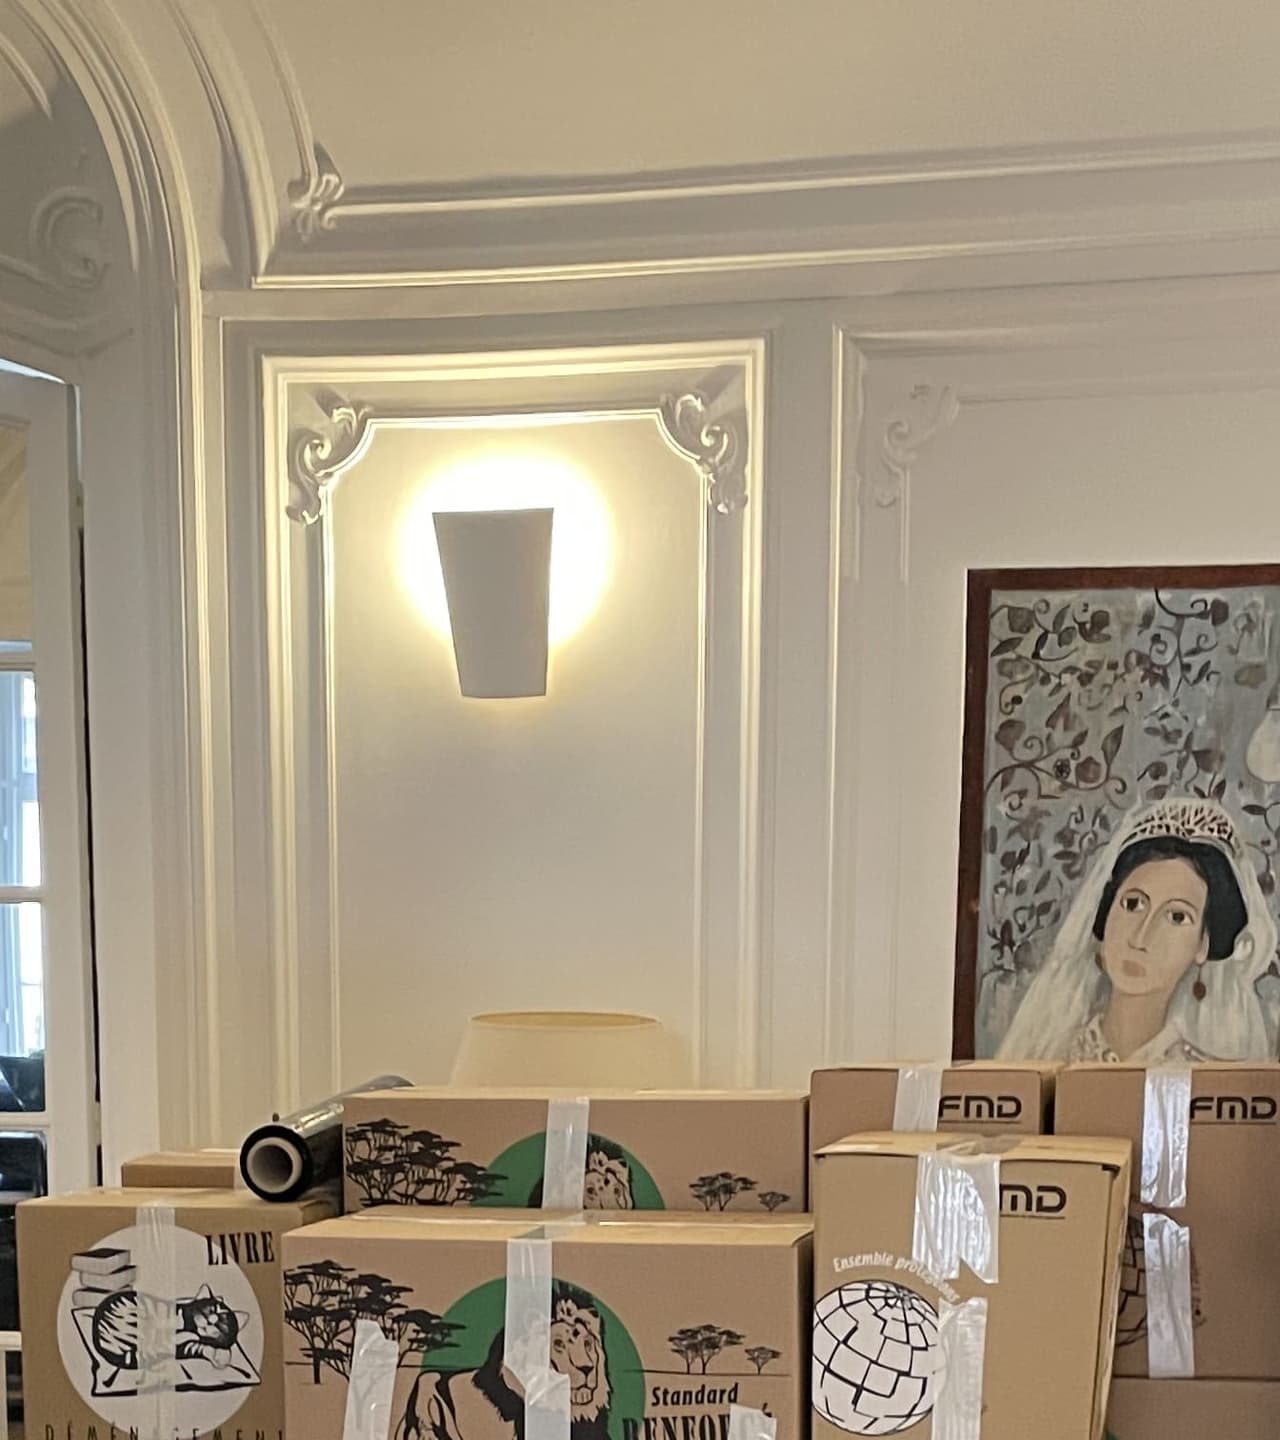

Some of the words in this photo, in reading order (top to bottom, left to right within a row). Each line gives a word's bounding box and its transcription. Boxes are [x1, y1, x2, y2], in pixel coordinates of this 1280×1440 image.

[939, 1095, 1022, 1119] FMD
[1190, 1097, 1277, 1120] FMD
[1000, 1184, 1067, 1213] MD
[205, 1231, 275, 1266] LIVRE
[833, 1251, 894, 1272] Ensemble
[652, 1382, 739, 1407] Standard
